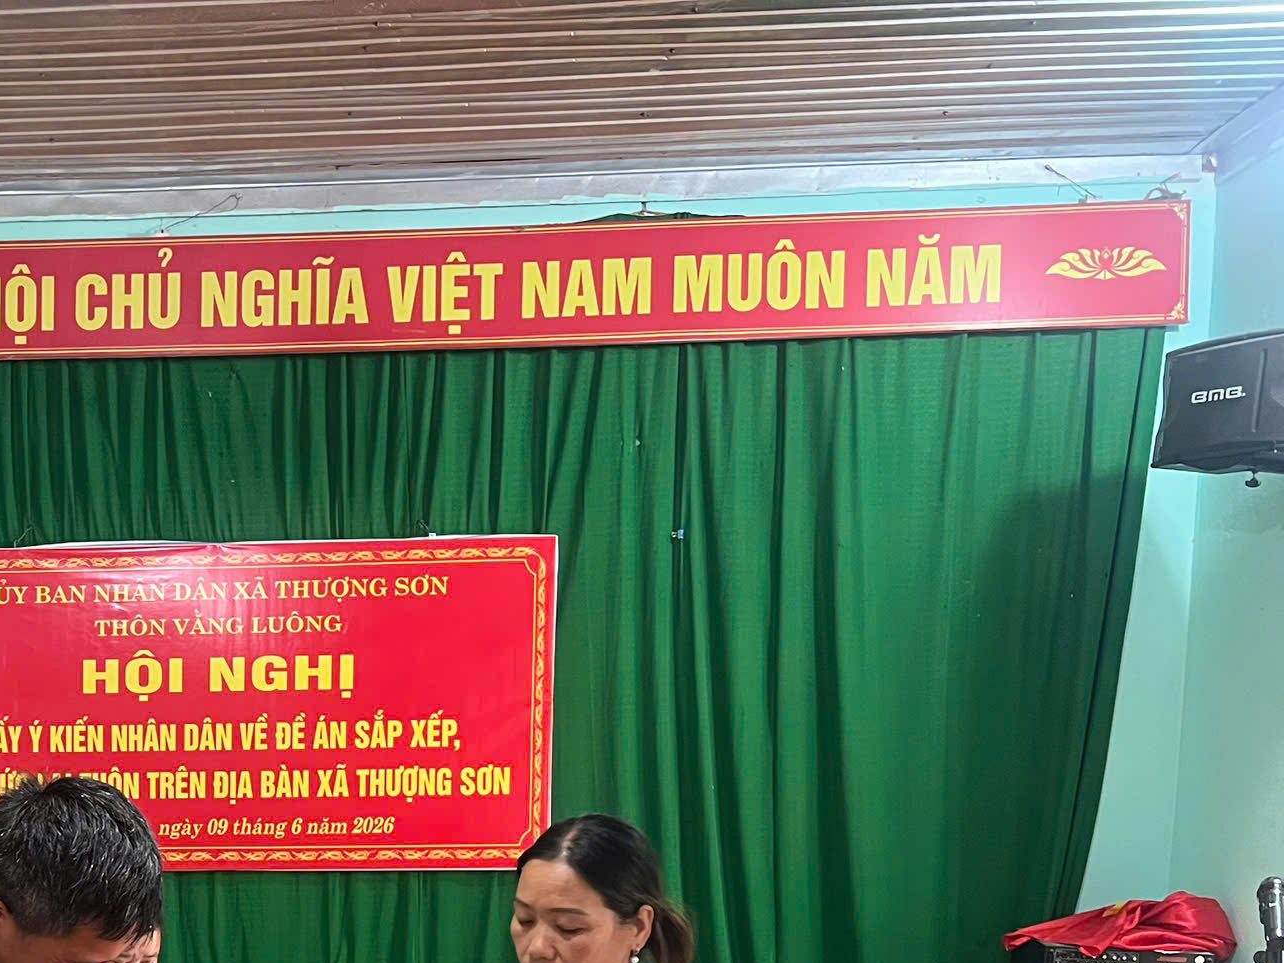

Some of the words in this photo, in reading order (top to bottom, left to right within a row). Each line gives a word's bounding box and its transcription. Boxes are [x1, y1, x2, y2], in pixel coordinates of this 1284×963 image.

[75, 247, 181, 331] CHỦ
[201, 256, 369, 328] NGHĨA
[387, 252, 503, 334] VIỆT
[521, 257, 652, 319] NAM
[672, 238, 845, 313] MUÔN
[866, 233, 1002, 308] NĂM
[35, 584, 86, 604] BAN
[93, 577, 165, 603] NHÂN
[170, 577, 227, 601] DÂN
[233, 576, 268, 600] XÃ
[274, 577, 387, 603] THƯỢNG
[394, 574, 448, 596] SƠN
[94, 614, 167, 637] THÔN
[172, 609, 244, 635] VẰNG
[252, 611, 343, 634] LUÔNG
[82, 649, 183, 702] HỘI
[209, 654, 354, 698] NGHỊ
[28, 720, 43, 753] Ý
[50, 715, 104, 753] KIẾN
[111, 718, 177, 752] NHÂN
[184, 717, 232, 751] DÂN
[240, 713, 268, 750] VỀ
[275, 712, 306, 750] ĐỀ
[313, 715, 347, 749] ÁN
[354, 709, 403, 749] SẮP
[410, 709, 461, 751] XẾP,
[147, 766, 206, 799] TRÊN
[213, 770, 253, 805] ĐỊA
[260, 764, 309, 798] BÀN
[317, 764, 349, 798] XÃ
[356, 764, 452, 803] THƯỢNG
[460, 764, 511, 796] SƠN
[158, 818, 203, 840] ngày
[207, 818, 229, 835] 09
[233, 817, 288, 839] tháng
[291, 818, 303, 835] 6
[306, 818, 348, 835] năm
[351, 816, 395, 834] 2026
